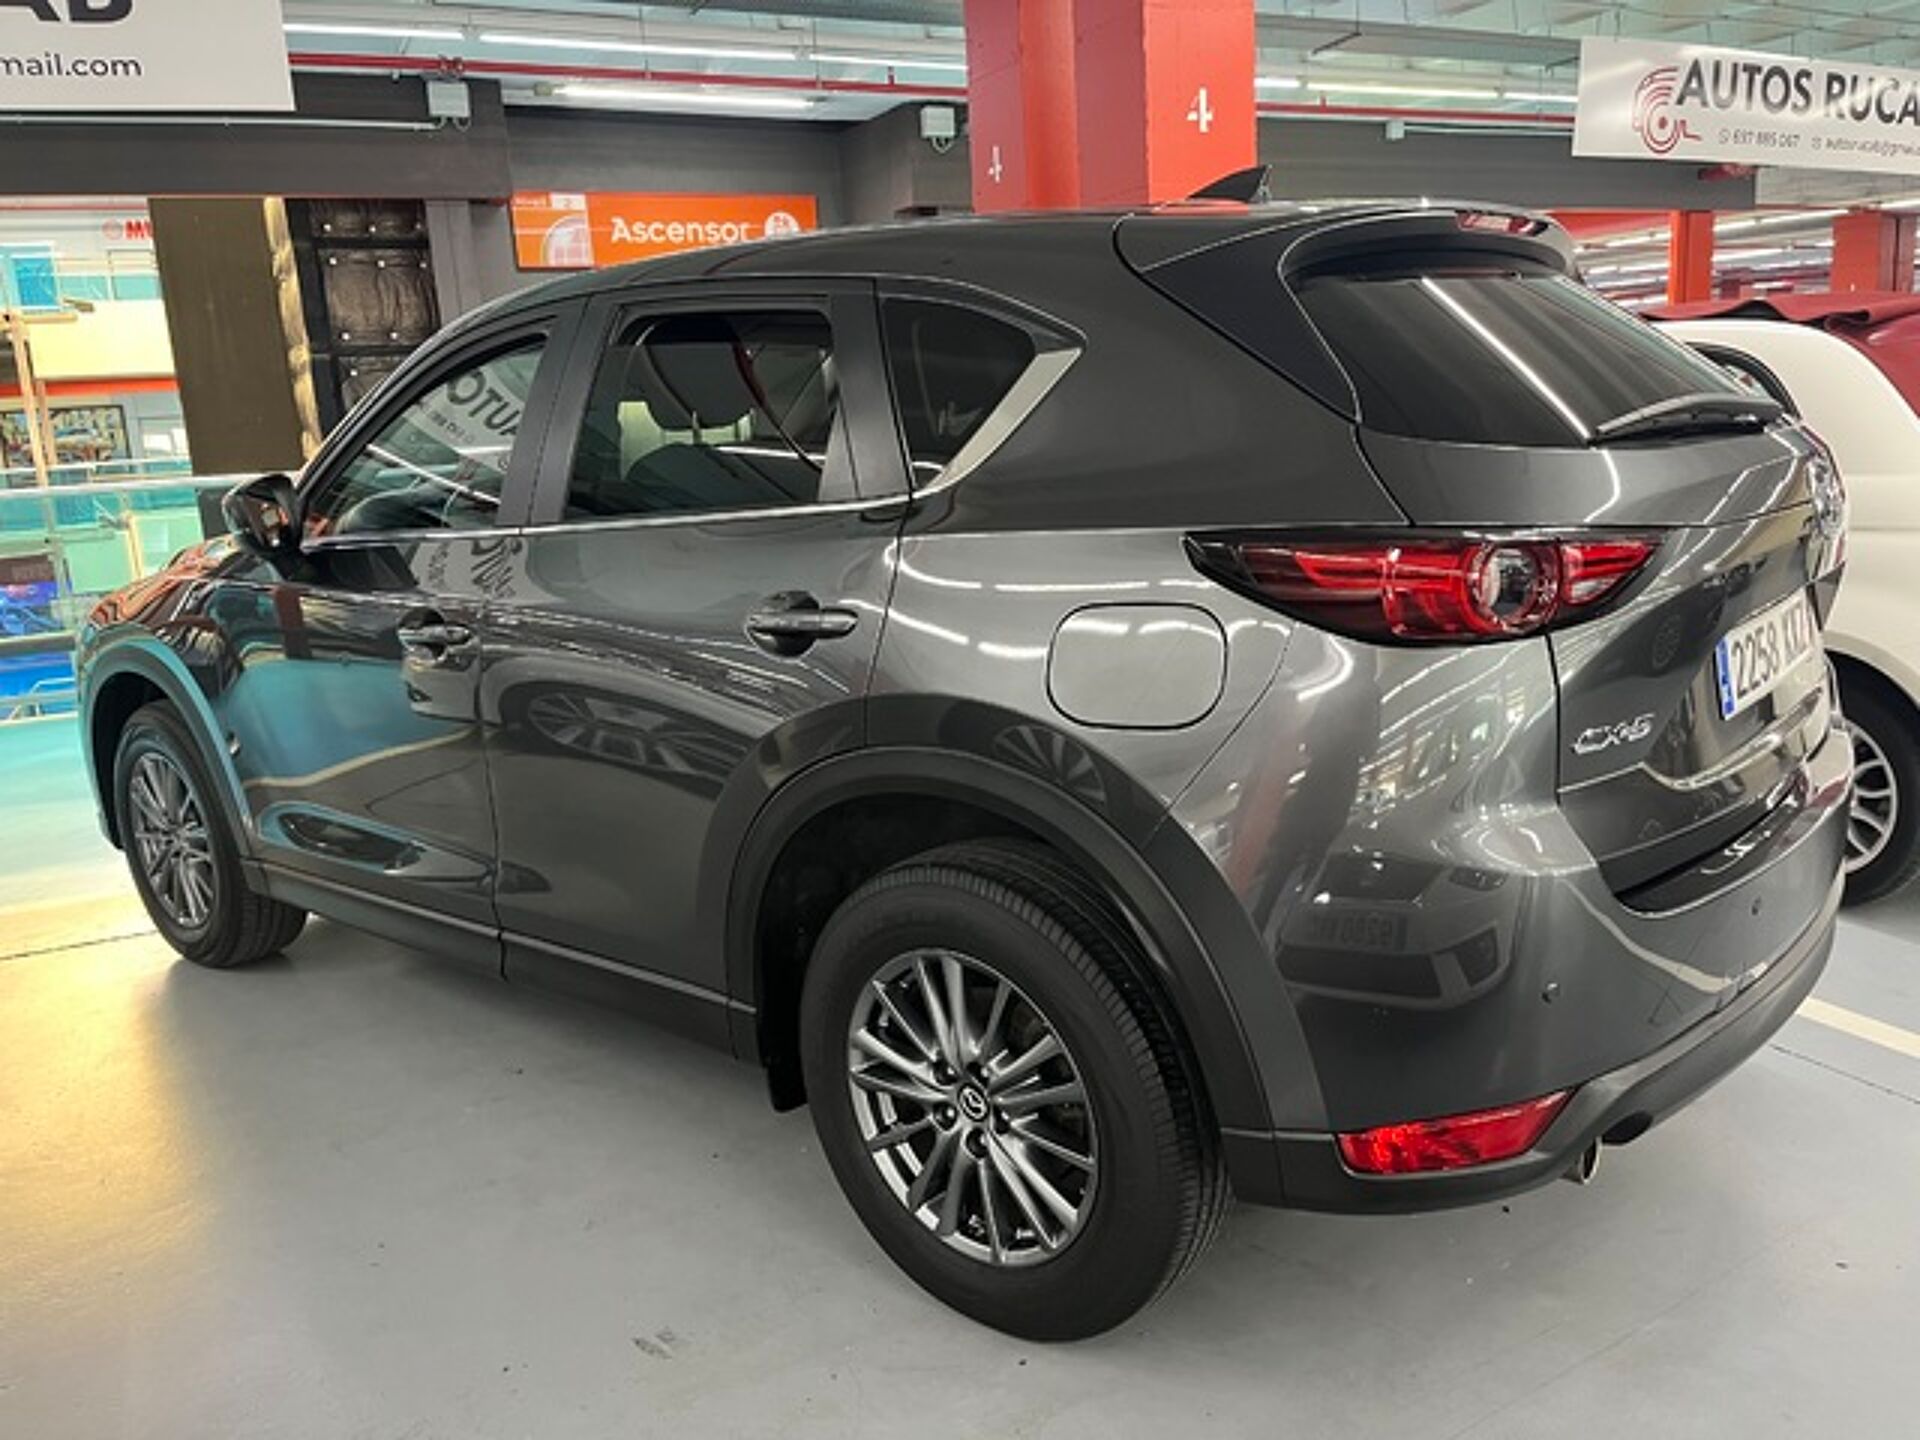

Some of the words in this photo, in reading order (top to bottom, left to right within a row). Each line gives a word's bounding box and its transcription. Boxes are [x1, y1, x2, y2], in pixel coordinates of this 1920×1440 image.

[1676, 58, 1812, 114] AUTOS
[1186, 87, 1214, 133] 4
[988, 146, 1003, 183] 4
[610, 216, 750, 244] Ascensor
[1731, 620, 1780, 699] 2258
